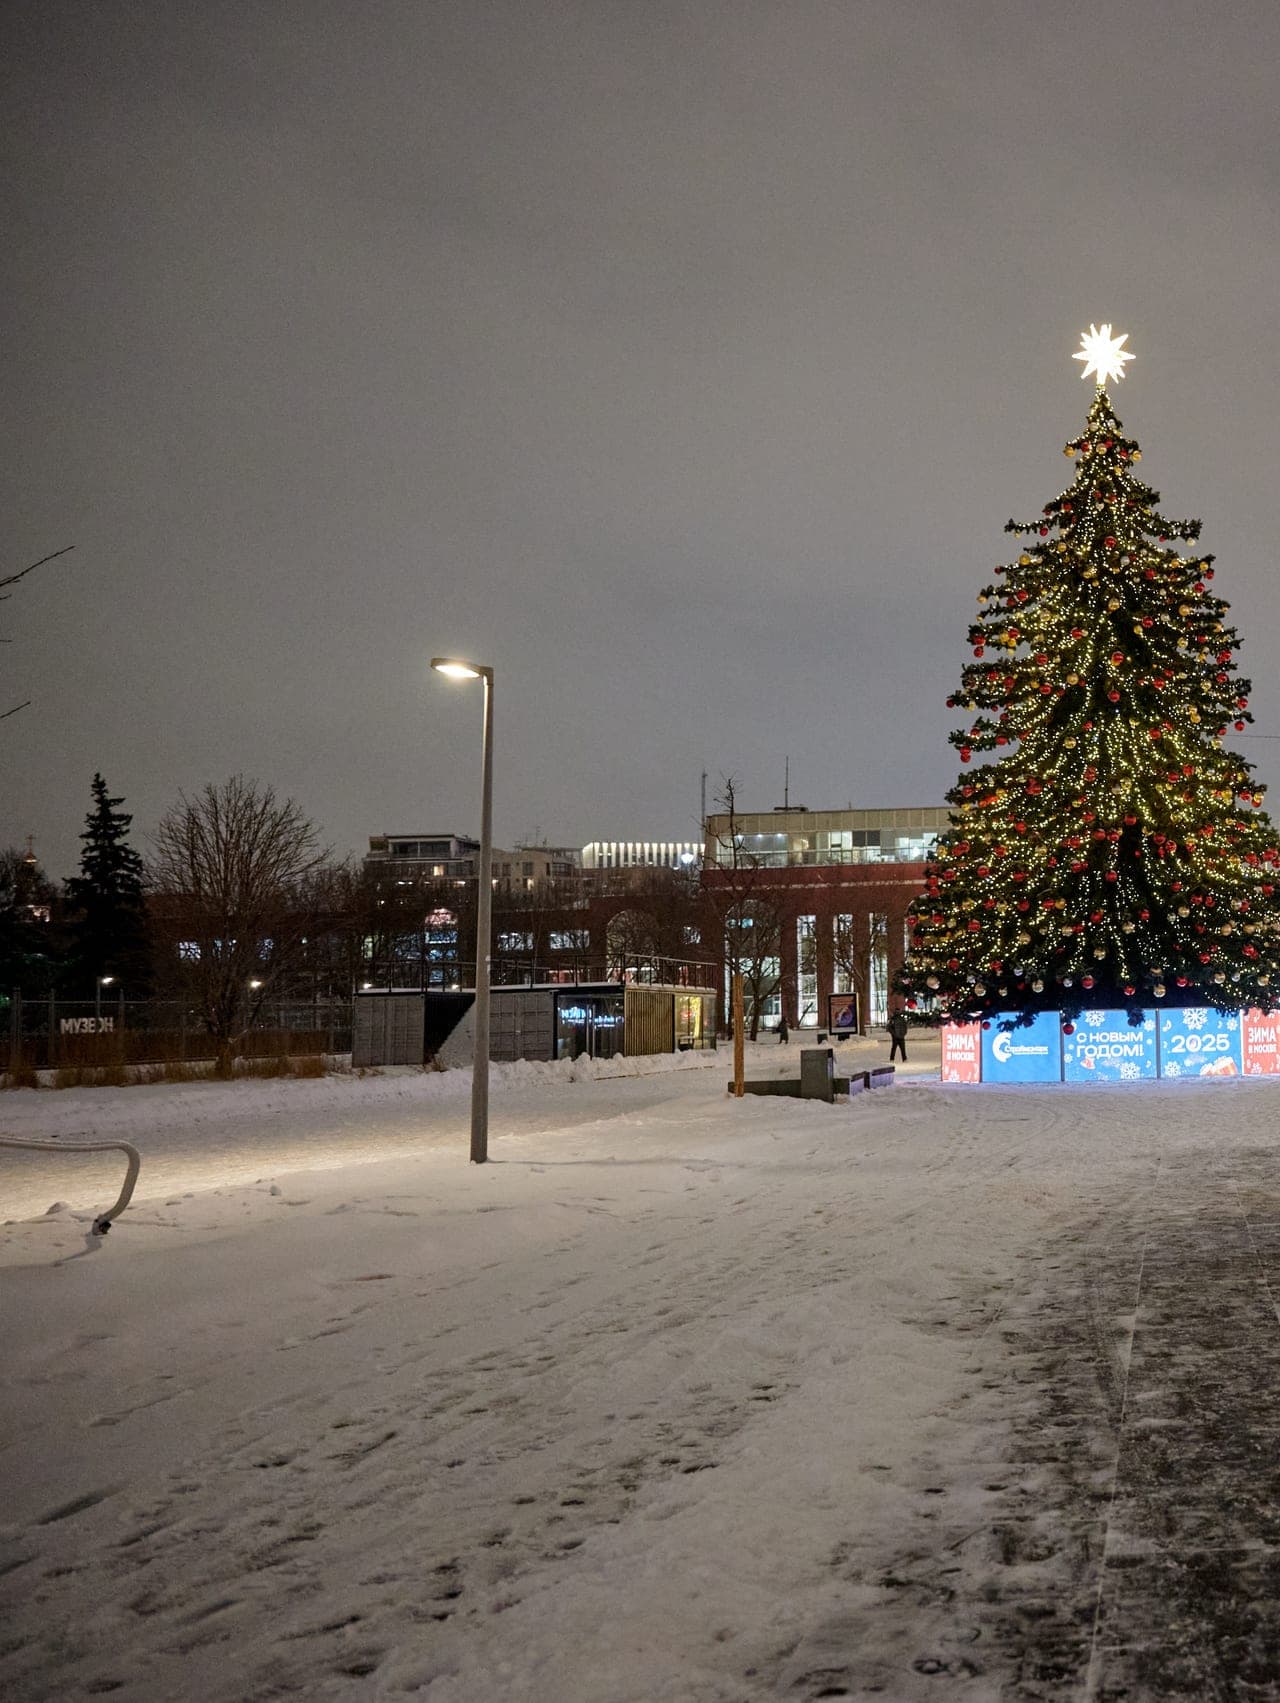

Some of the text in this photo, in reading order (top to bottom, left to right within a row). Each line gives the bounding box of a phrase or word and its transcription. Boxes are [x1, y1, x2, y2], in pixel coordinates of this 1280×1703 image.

[946, 1034, 975, 1050] ЗИМА
[1076, 1031, 1144, 1043] С НОВЫМ
[1171, 1033, 1231, 1053] 2025
[1248, 1027, 1276, 1043] ЗИМА
[1076, 1044, 1145, 1059] ГОДОМ!
